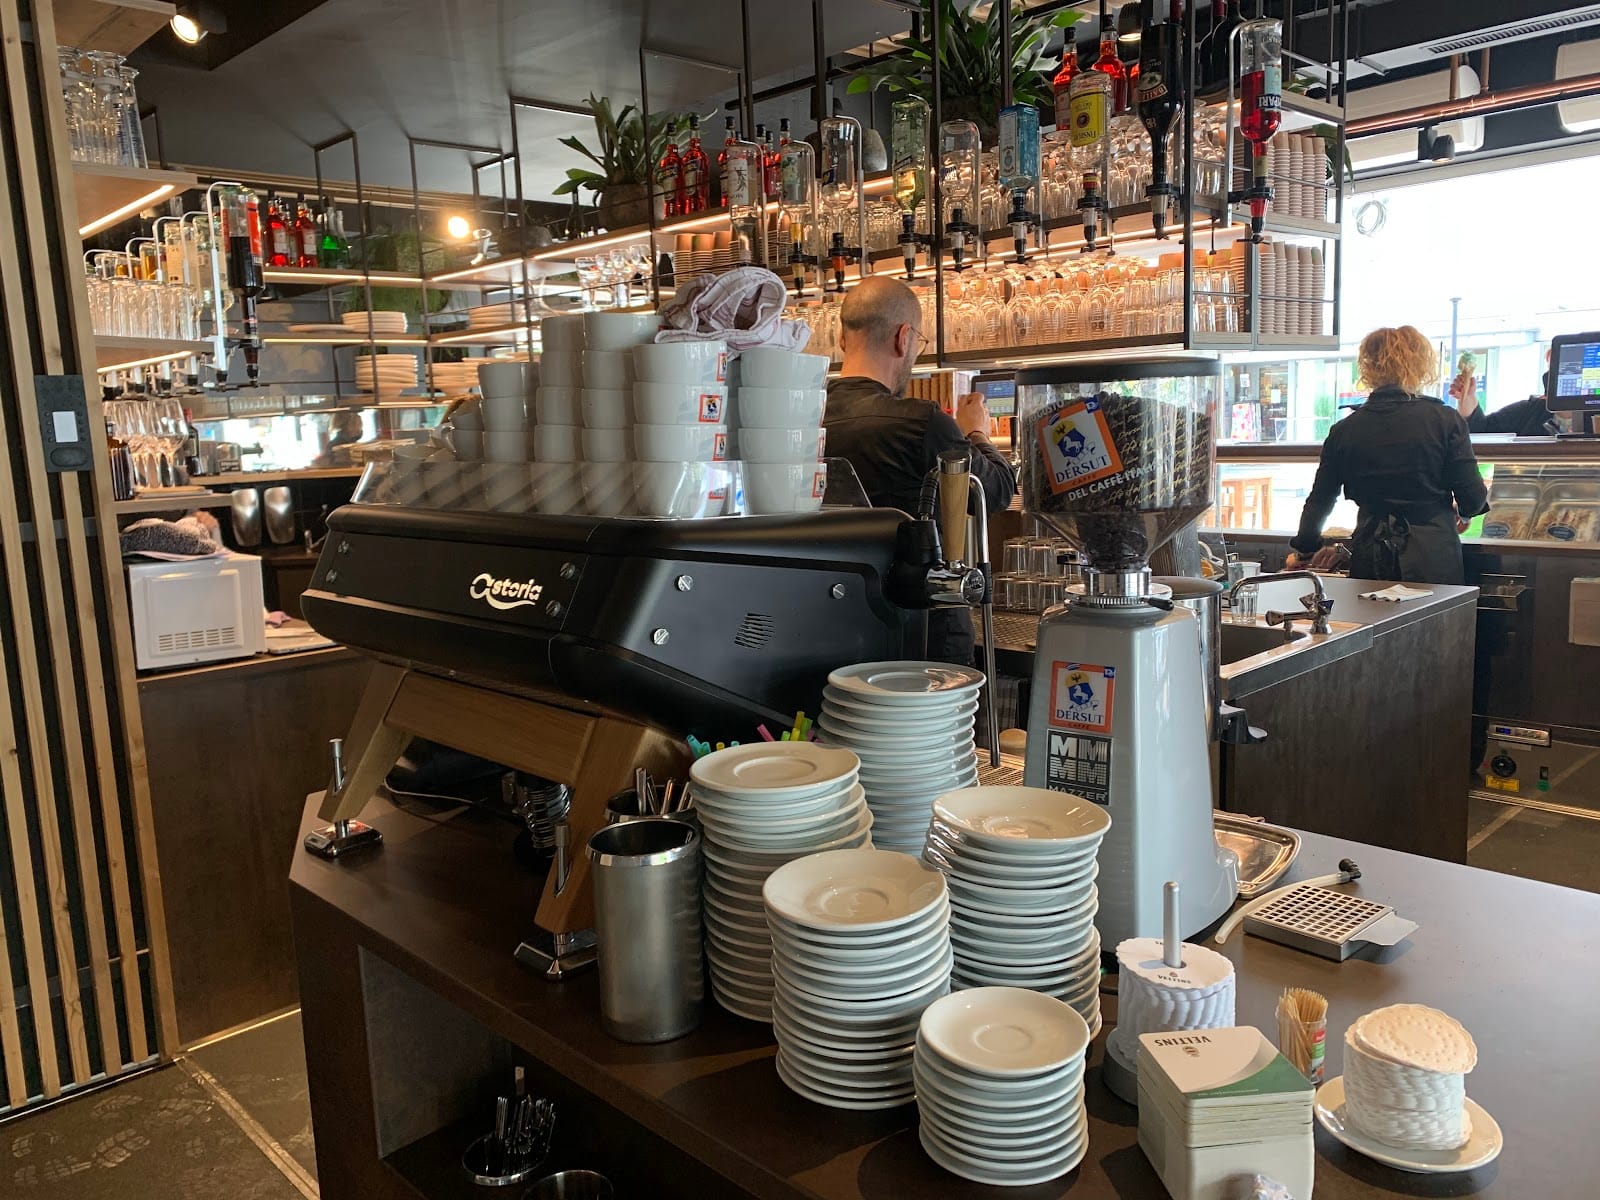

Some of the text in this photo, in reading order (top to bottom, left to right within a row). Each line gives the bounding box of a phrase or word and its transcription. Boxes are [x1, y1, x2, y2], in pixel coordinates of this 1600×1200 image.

[1056, 455, 1110, 483] DERSUT
[1067, 487, 1089, 502] DEL
[1089, 471, 1124, 495] CAFFÈ
[1056, 708, 1104, 724] DERSUT
[1157, 974, 1192, 985] VELTINS
[1154, 1035, 1212, 1047] VELTINS
